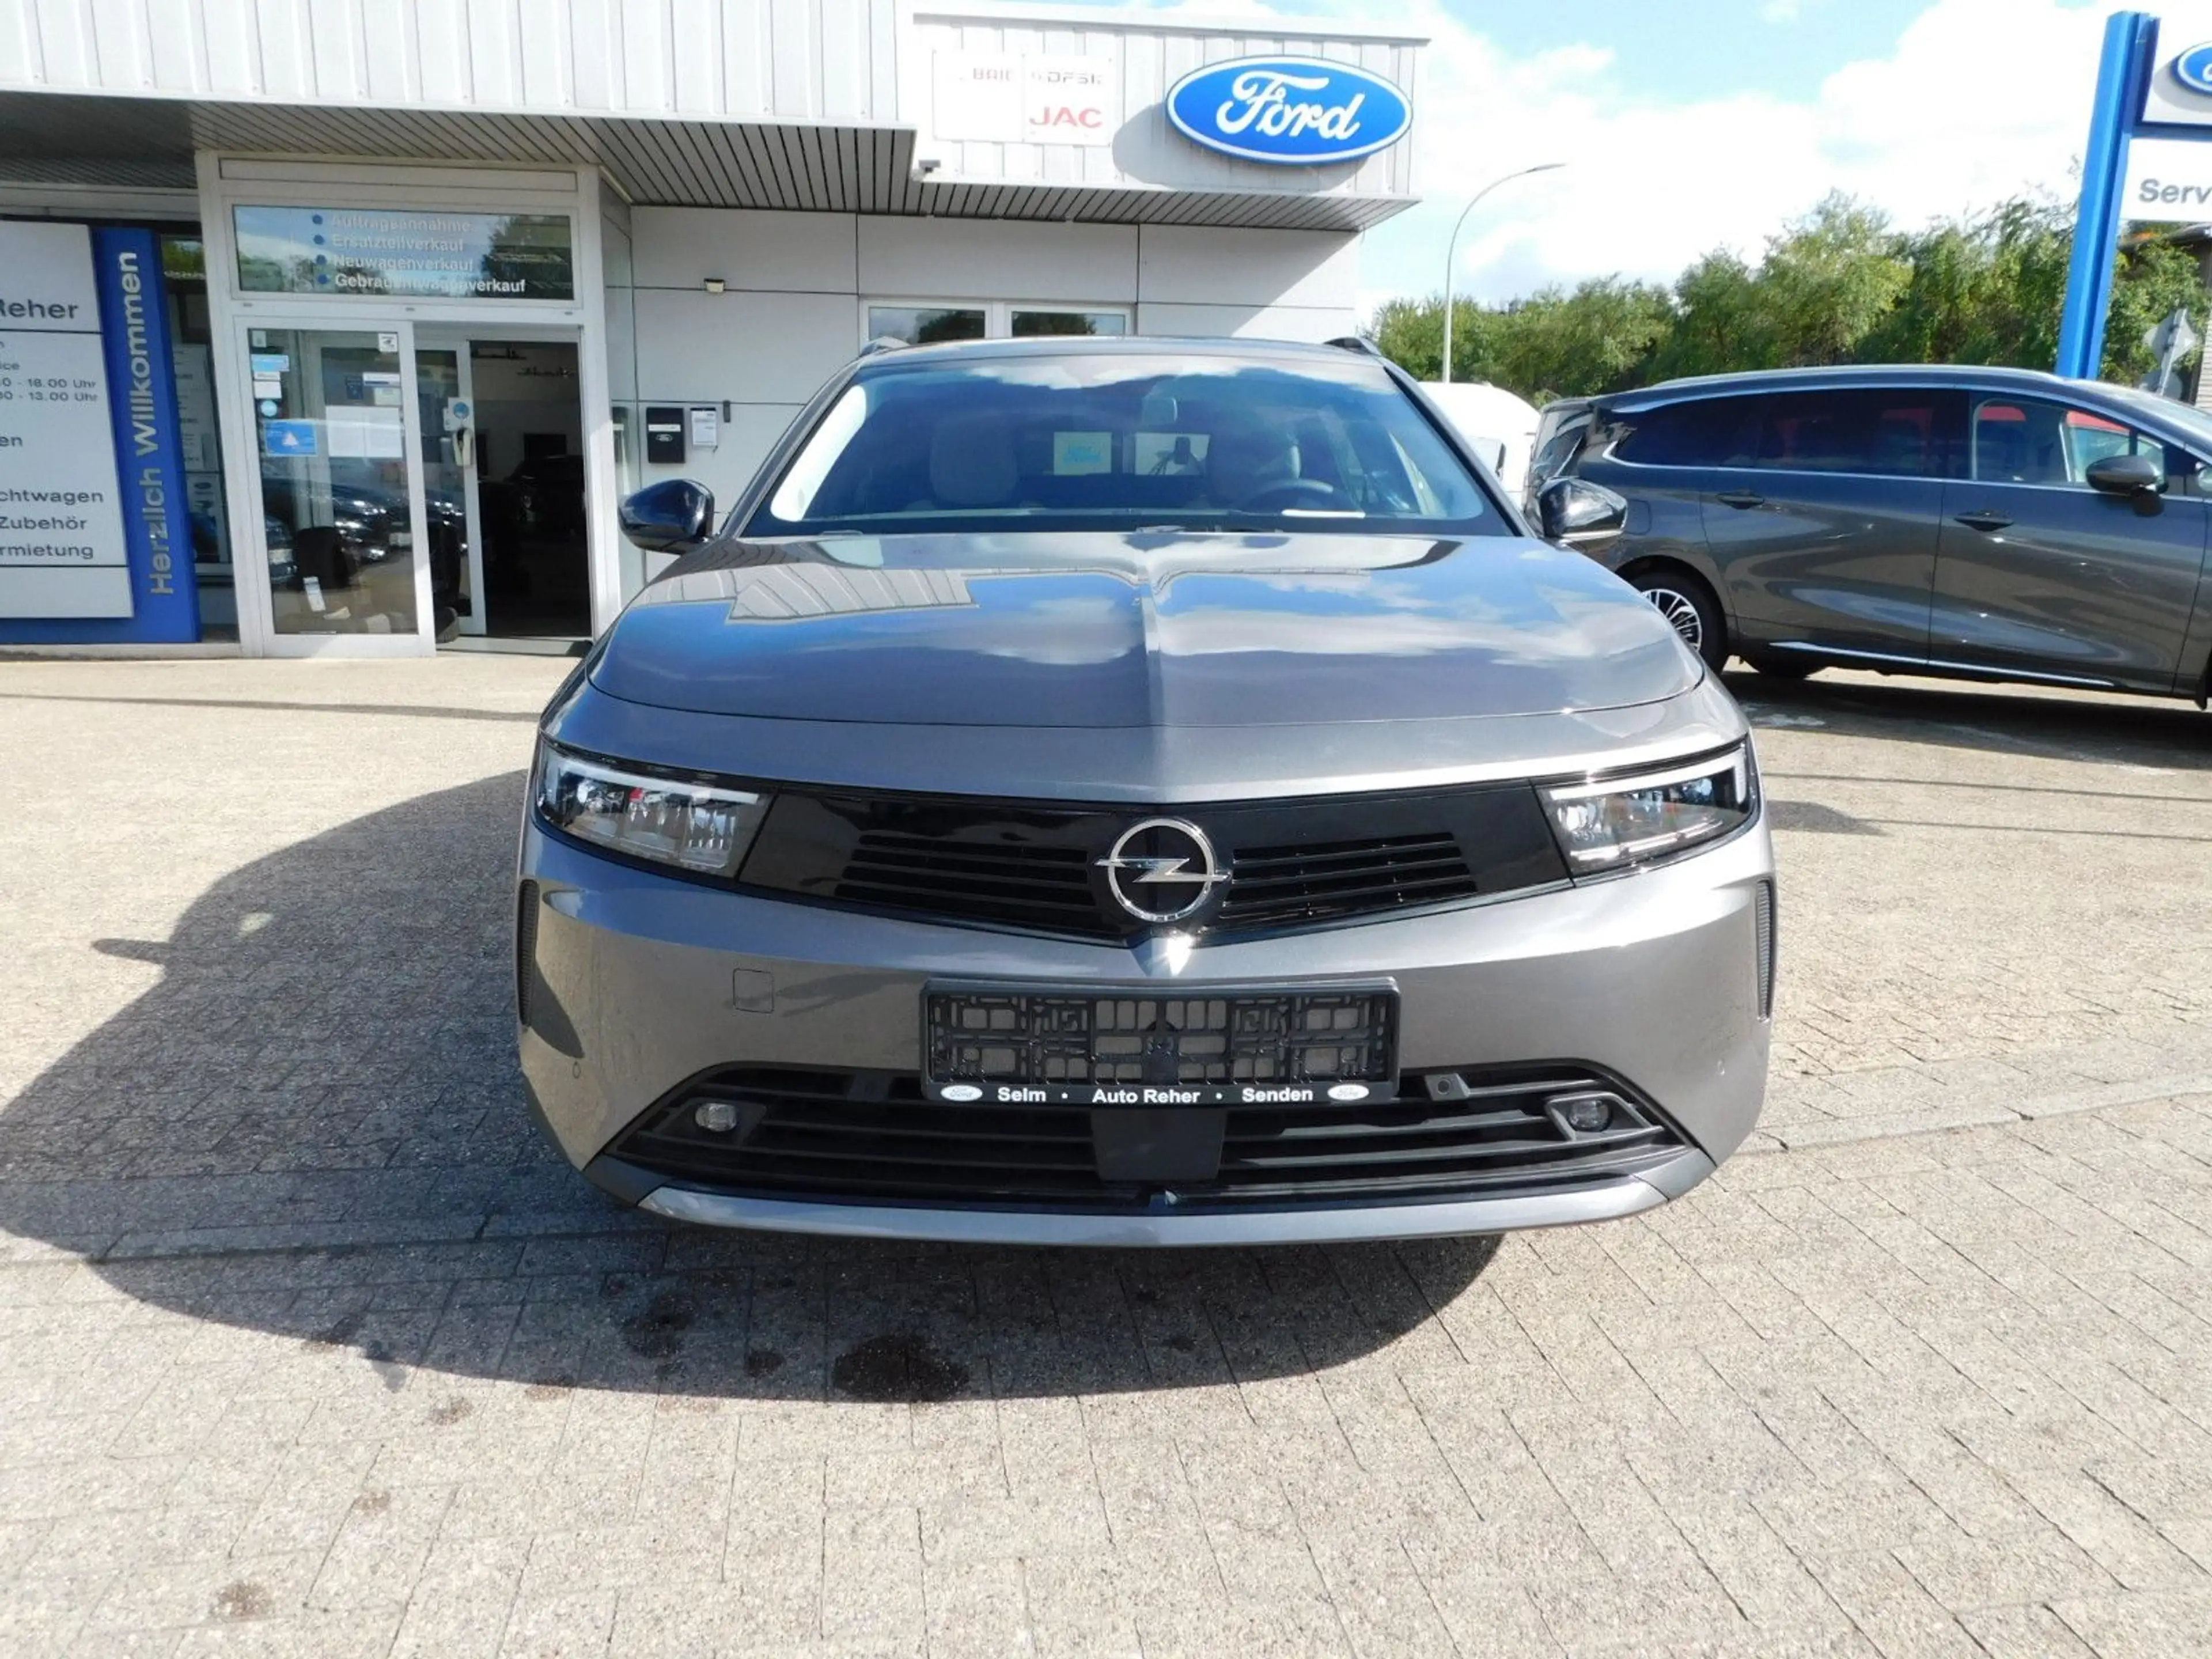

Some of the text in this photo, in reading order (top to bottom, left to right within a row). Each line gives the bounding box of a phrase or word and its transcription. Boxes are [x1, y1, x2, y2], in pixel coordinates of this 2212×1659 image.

[1215, 70, 1366, 140] Ford
[1028, 105, 1103, 129] JAC
[2138, 177, 2212, 204] Serv
[334, 254, 474, 272] Neuwagenverkauf
[73, 378, 97, 388] Uhr
[118, 251, 174, 594] Herzlich Willkommen
[0, 516, 88, 530] Zubehör
[1092, 1088, 1138, 1103] Auto
[1143, 1088, 1201, 1103] Reher
[1242, 1086, 1313, 1103] Senden
